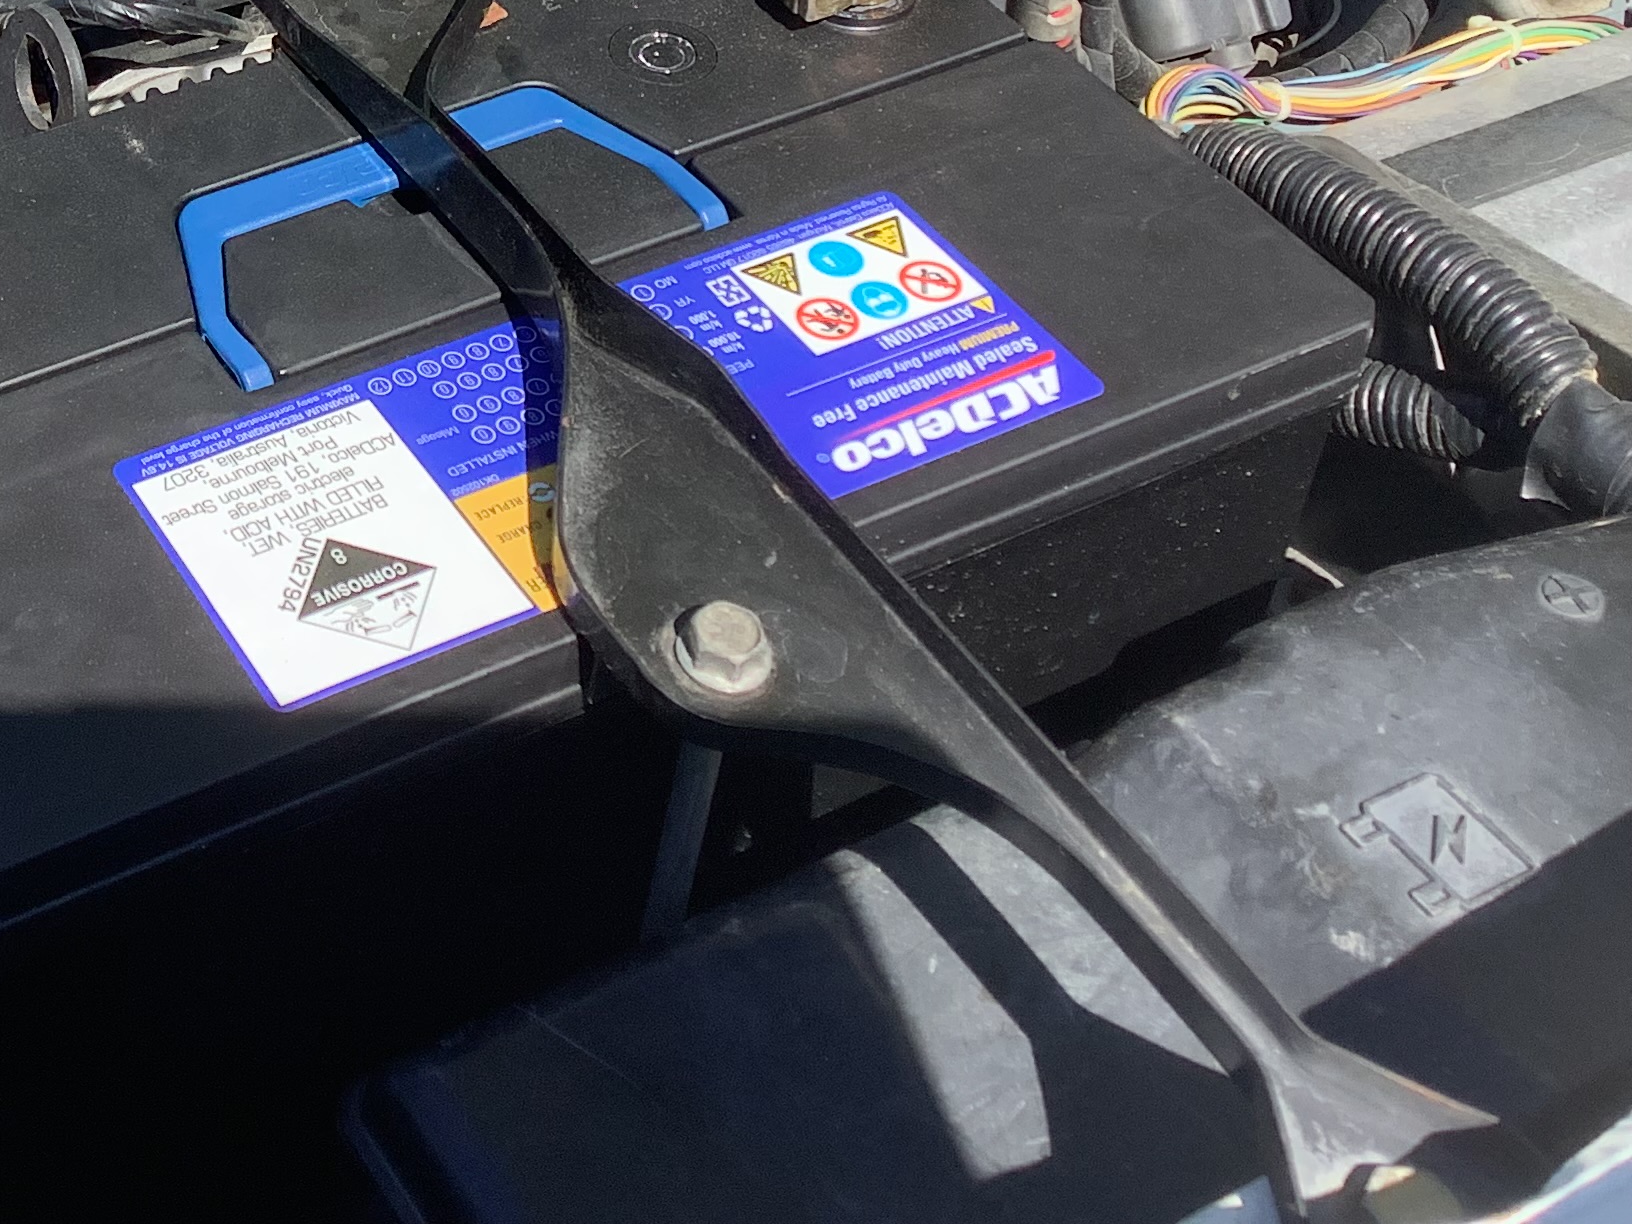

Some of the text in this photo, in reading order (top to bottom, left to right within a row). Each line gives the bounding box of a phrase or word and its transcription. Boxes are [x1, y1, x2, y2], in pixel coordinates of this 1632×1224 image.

[653, 274, 677, 289] MO
[673, 294, 695, 307] YR
[874, 304, 974, 351] ATTENTION!
[848, 319, 1019, 391] PREMIUM Heavy Duty Battery
[304, 391, 360, 416] MAXIMUM
[811, 335, 1038, 431] Sealed Maintenance Free
[234, 411, 304, 442] RECHARGING
[414, 422, 459, 447] Mileage
[828, 363, 1058, 473] ACDelco
[160, 405, 360, 491] Victoria, Australia, 3207
[187, 436, 235, 458] VOLTAGE
[202, 433, 337, 494] Port Melbourne,
[446, 444, 517, 477] INSTALLED
[160, 429, 395, 528] ACDelco, 191 Salmon Street
[226, 464, 355, 521] electric storage
[221, 473, 383, 544] FILLED WITH ACID,
[240, 491, 387, 557] BATTERIES, WET,
[473, 496, 523, 521] REPLACE
[329, 546, 347, 564] 8
[495, 524, 530, 543] ARGE
[277, 534, 320, 614] UN2794
[309, 559, 408, 608] CORROSIVE
